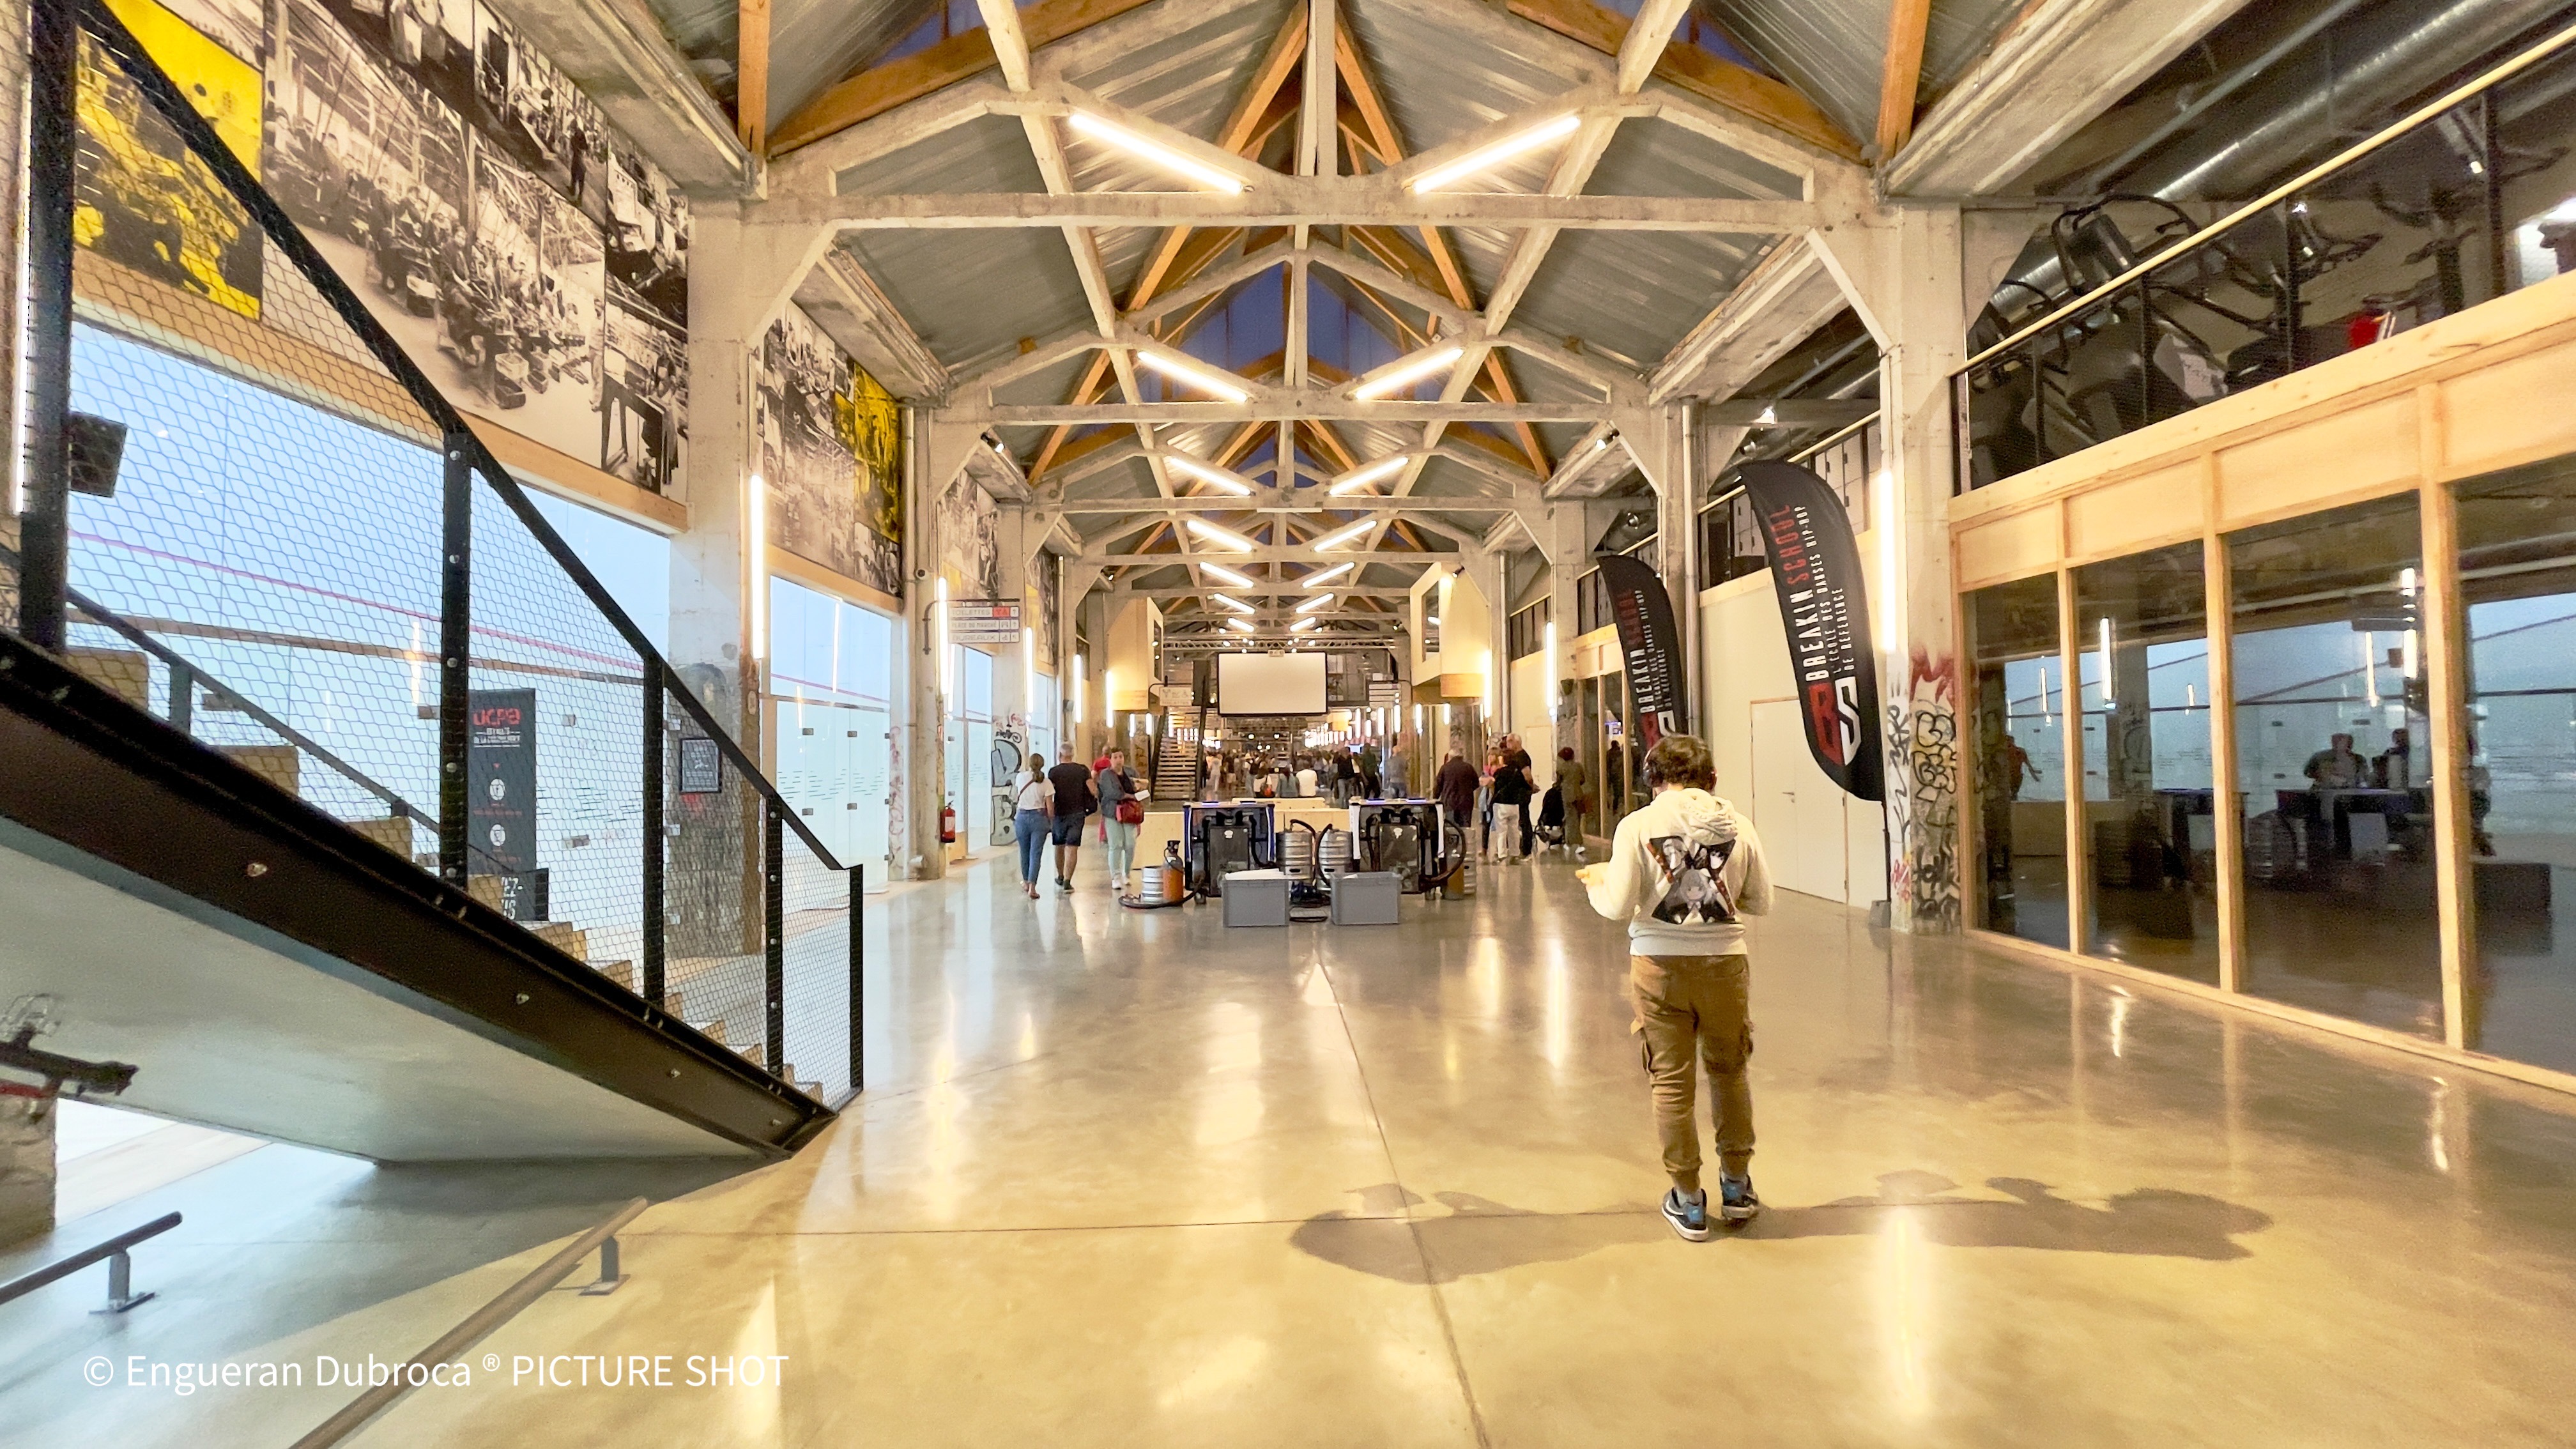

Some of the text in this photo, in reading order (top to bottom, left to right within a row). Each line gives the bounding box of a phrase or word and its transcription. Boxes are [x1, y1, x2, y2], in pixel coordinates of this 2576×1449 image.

[1794, 506, 1817, 548] HIP-HOP
[1769, 505, 1830, 682] BREAKIN SCHOOL
[1809, 554, 1828, 594] DANSES
[1820, 601, 1834, 621] DES
[1630, 648, 1656, 713] BREAKIN
[1842, 658, 1855, 671] DE
